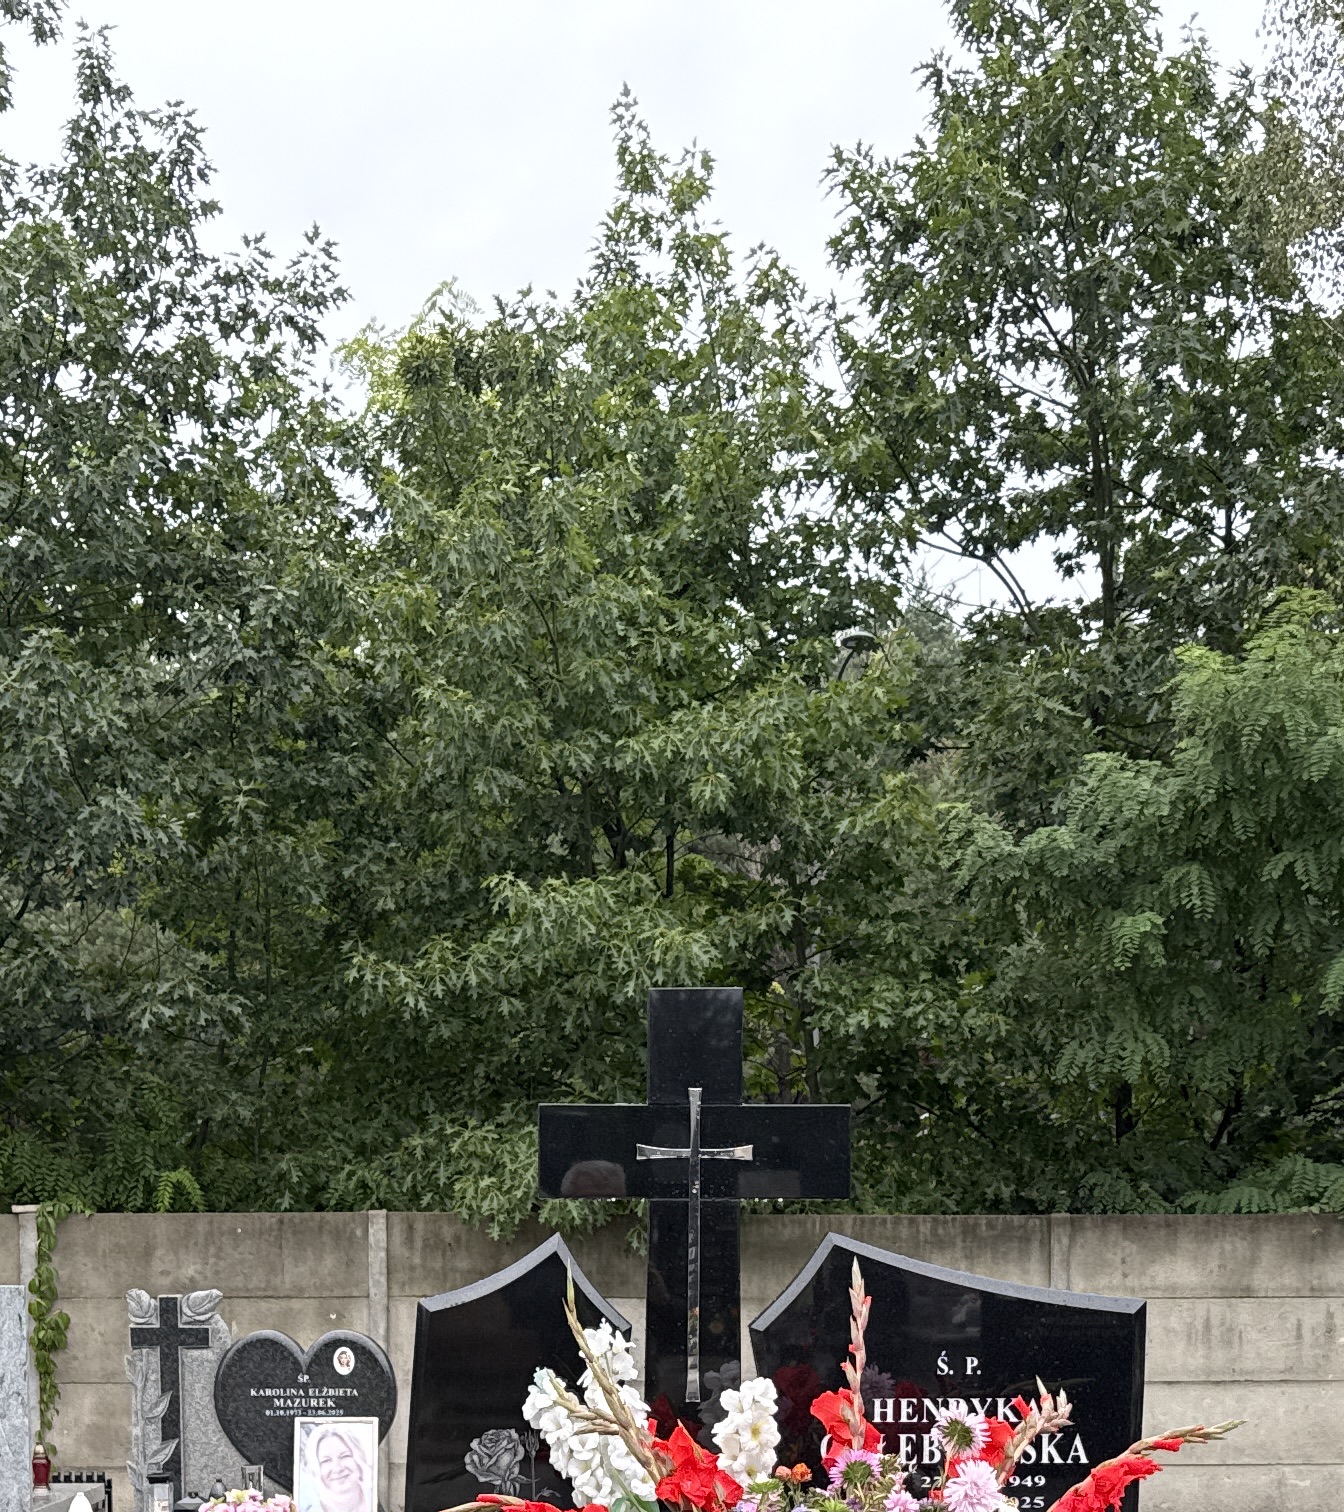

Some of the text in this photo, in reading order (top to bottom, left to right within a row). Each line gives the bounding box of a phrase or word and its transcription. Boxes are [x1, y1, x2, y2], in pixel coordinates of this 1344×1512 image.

[250, 1386, 359, 1397] KAROLINA ELŻBIETA
[273, 1398, 336, 1408] MAZUREK
